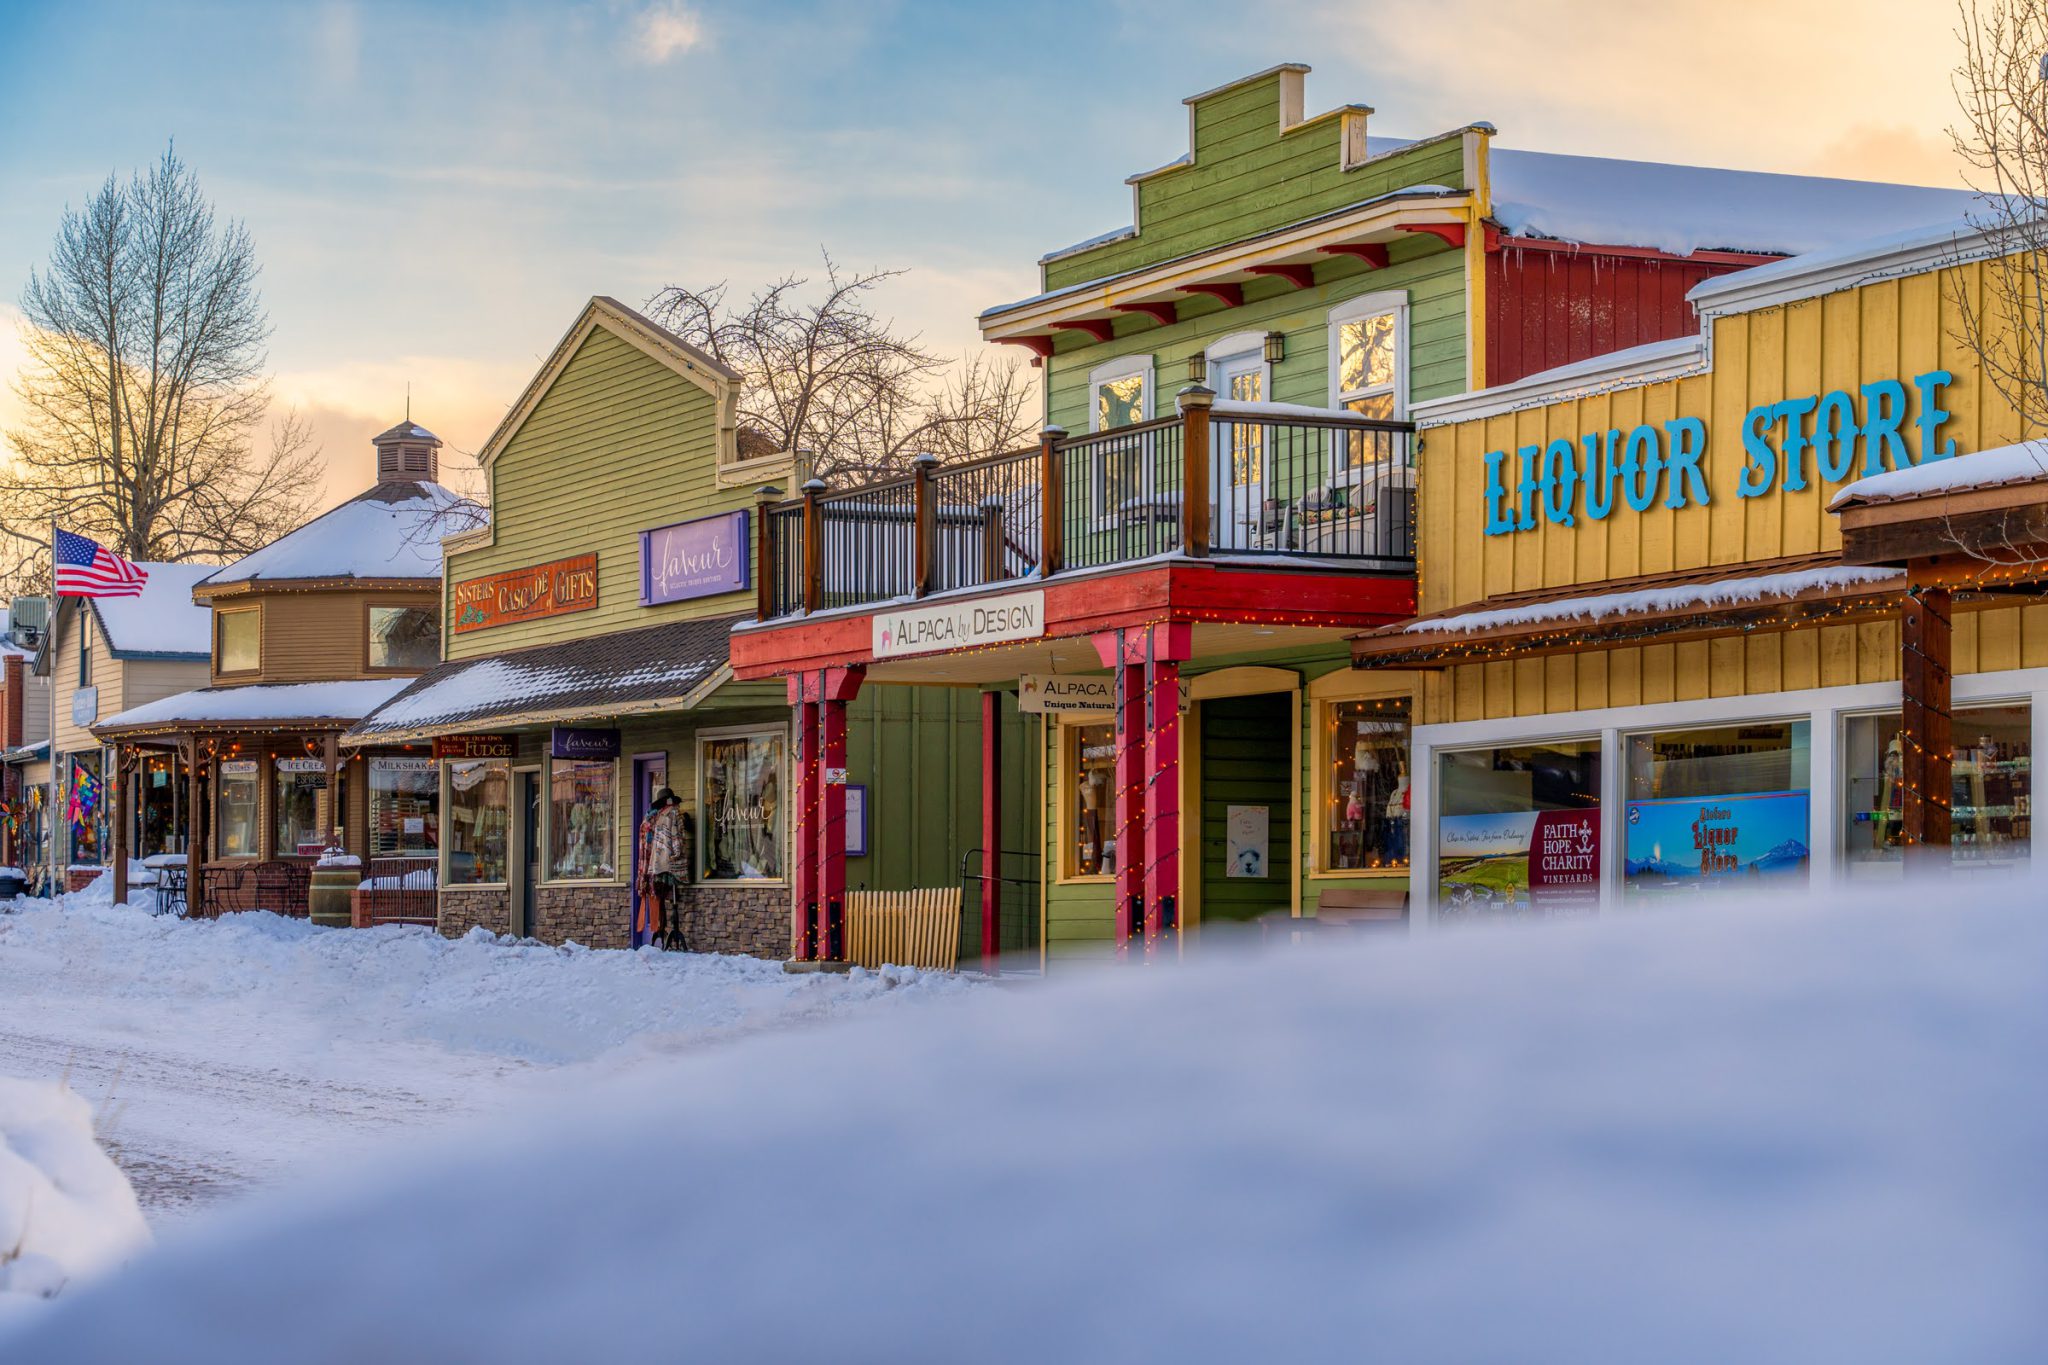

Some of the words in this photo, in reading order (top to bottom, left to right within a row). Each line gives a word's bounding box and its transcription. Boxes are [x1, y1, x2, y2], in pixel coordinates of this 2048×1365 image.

[1483, 416, 1711, 537] LIQUOR
[1736, 370, 1957, 499] STORE
[651, 530, 733, 597] faveur
[457, 581, 495, 606] SISTERS
[498, 571, 549, 614] CASCADE
[554, 571, 594, 604] GIFTS
[896, 617, 955, 647] ALPACA
[957, 614, 971, 644] by
[973, 604, 1034, 636] DESIGN
[1044, 681, 1108, 696] ALPACA
[1044, 700, 1077, 709] Unique
[1079, 701, 1115, 710] Natural
[464, 741, 513, 757] FUDGE
[287, 761, 300, 770] ICE
[302, 761, 326, 770] CREA
[296, 774, 328, 785] ESPRESS
[714, 789, 772, 834] faveur
[1543, 823, 1578, 839] FAITH
[1691, 820, 1739, 850] Liquor
[1543, 840, 1572, 855] HOPE
[1542, 855, 1593, 871] CHARITY
[1701, 848, 1738, 876] Store
[1543, 873, 1593, 883] VINEYARDS
